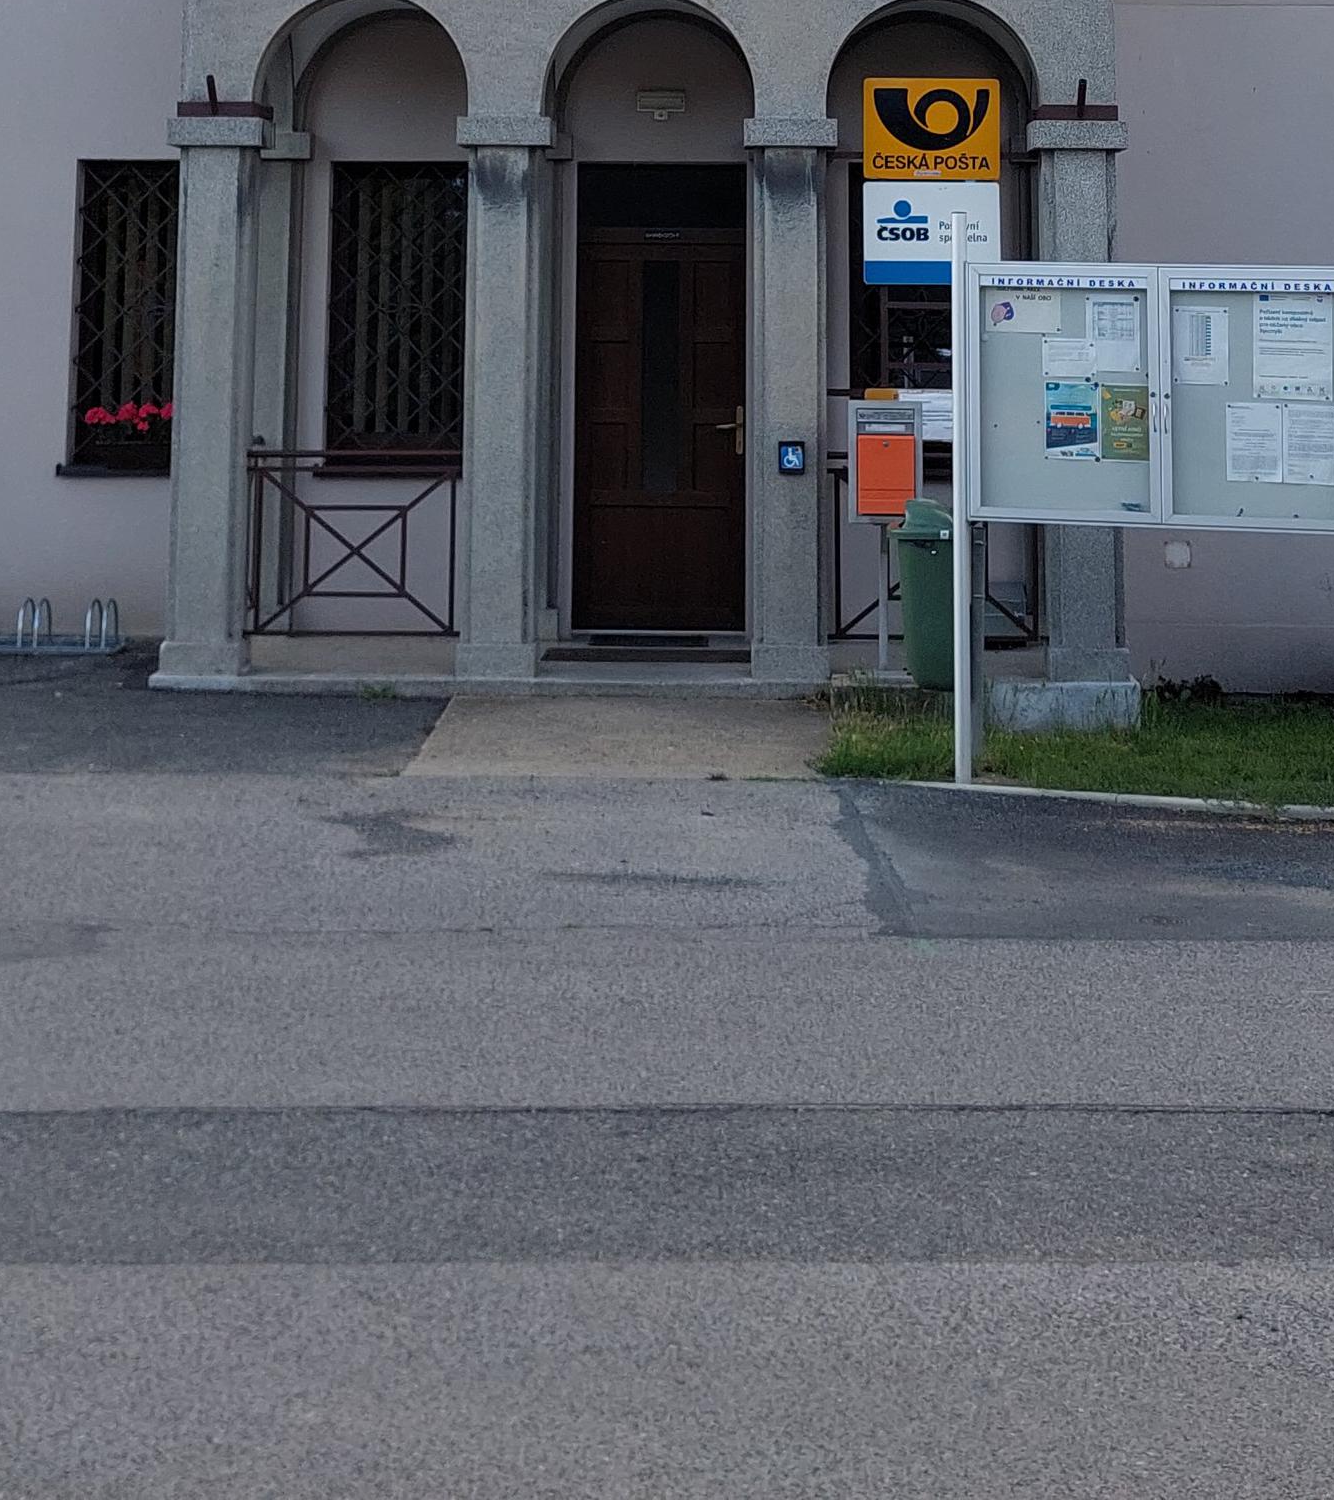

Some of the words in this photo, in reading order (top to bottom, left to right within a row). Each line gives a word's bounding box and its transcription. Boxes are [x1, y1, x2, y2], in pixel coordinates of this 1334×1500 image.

[872, 152, 930, 170] ČESKÁ
[933, 153, 990, 170] POŠTA
[876, 225, 929, 241] ČSOB
[991, 277, 1080, 287] INFORMAČNÍ
[1089, 279, 1135, 288] DESKA
[1182, 281, 1275, 291] INFORMAČNÍ
[1284, 283, 1332, 291] DESKA
